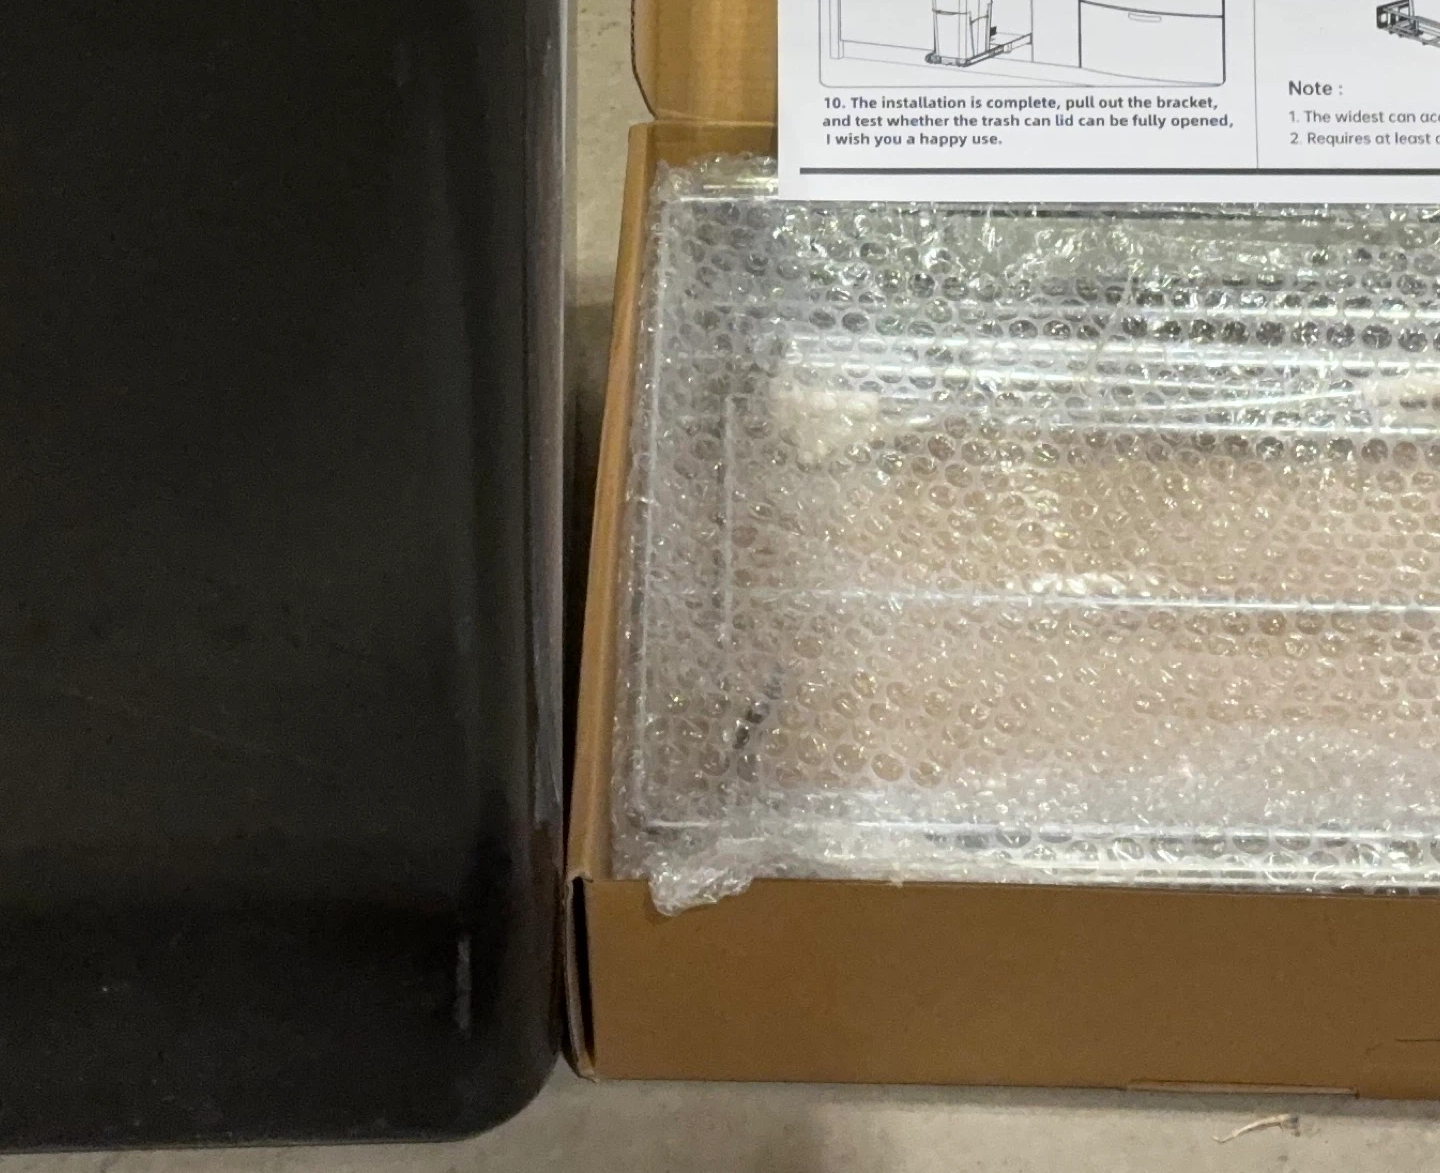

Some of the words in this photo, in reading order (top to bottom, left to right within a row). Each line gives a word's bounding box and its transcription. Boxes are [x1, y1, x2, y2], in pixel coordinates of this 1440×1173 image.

[1289, 79, 1332, 97] Note
[824, 96, 846, 110] 10.
[851, 95, 877, 110] The
[882, 95, 966, 109] installation
[971, 95, 982, 109] is
[986, 95, 1060, 113] complete,
[1066, 94, 1095, 112] pull
[1099, 96, 1124, 109] out
[1128, 95, 1152, 109] the
[1157, 95, 1217, 111] bracket,
[823, 113, 851, 128] and
[855, 115, 883, 128] test
[887, 113, 950, 128] whether
[953, 113, 978, 128] the
[982, 113, 1020, 128] trash
[1024, 116, 1051, 127] can
[1055, 113, 1073, 127] lid
[1078, 116, 1105, 127] can
[1110, 113, 1128, 127] be
[1132, 113, 1166, 130] fully
[1171, 113, 1233, 130] opened,
[1289, 109, 1300, 124] 1.
[1303, 108, 1331, 124] The
[1335, 109, 1385, 124] widest
[1389, 112, 1416, 124] can
[826, 134, 831, 145] I
[835, 131, 870, 146] wish
[874, 134, 902, 149] you
[906, 135, 915, 146] a
[920, 131, 967, 149] happy
[972, 135, 1002, 146] use.
[1290, 131, 1302, 146] 2.
[1307, 130, 1371, 148] Requires
[1375, 132, 1391, 146] at
[1395, 131, 1431, 146] least
